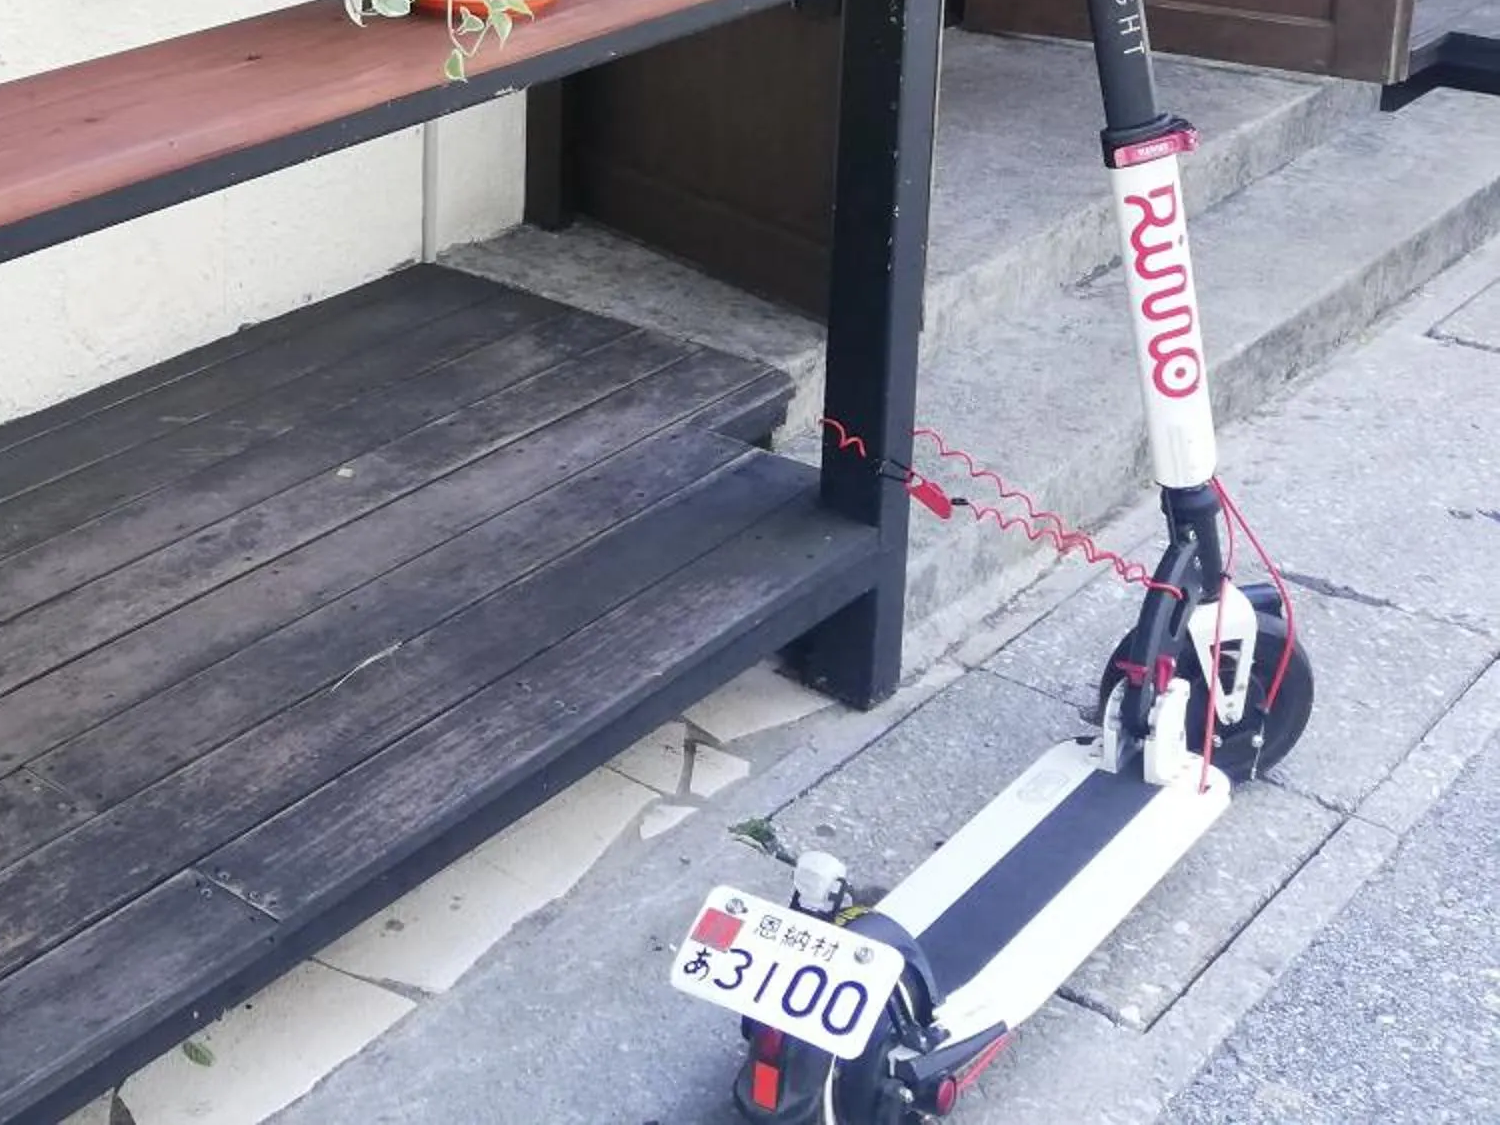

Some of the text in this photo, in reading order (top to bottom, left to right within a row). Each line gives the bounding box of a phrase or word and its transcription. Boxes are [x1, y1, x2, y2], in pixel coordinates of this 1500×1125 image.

[754, 914, 839, 962] 恩納村
[713, 947, 869, 1036] 3100
